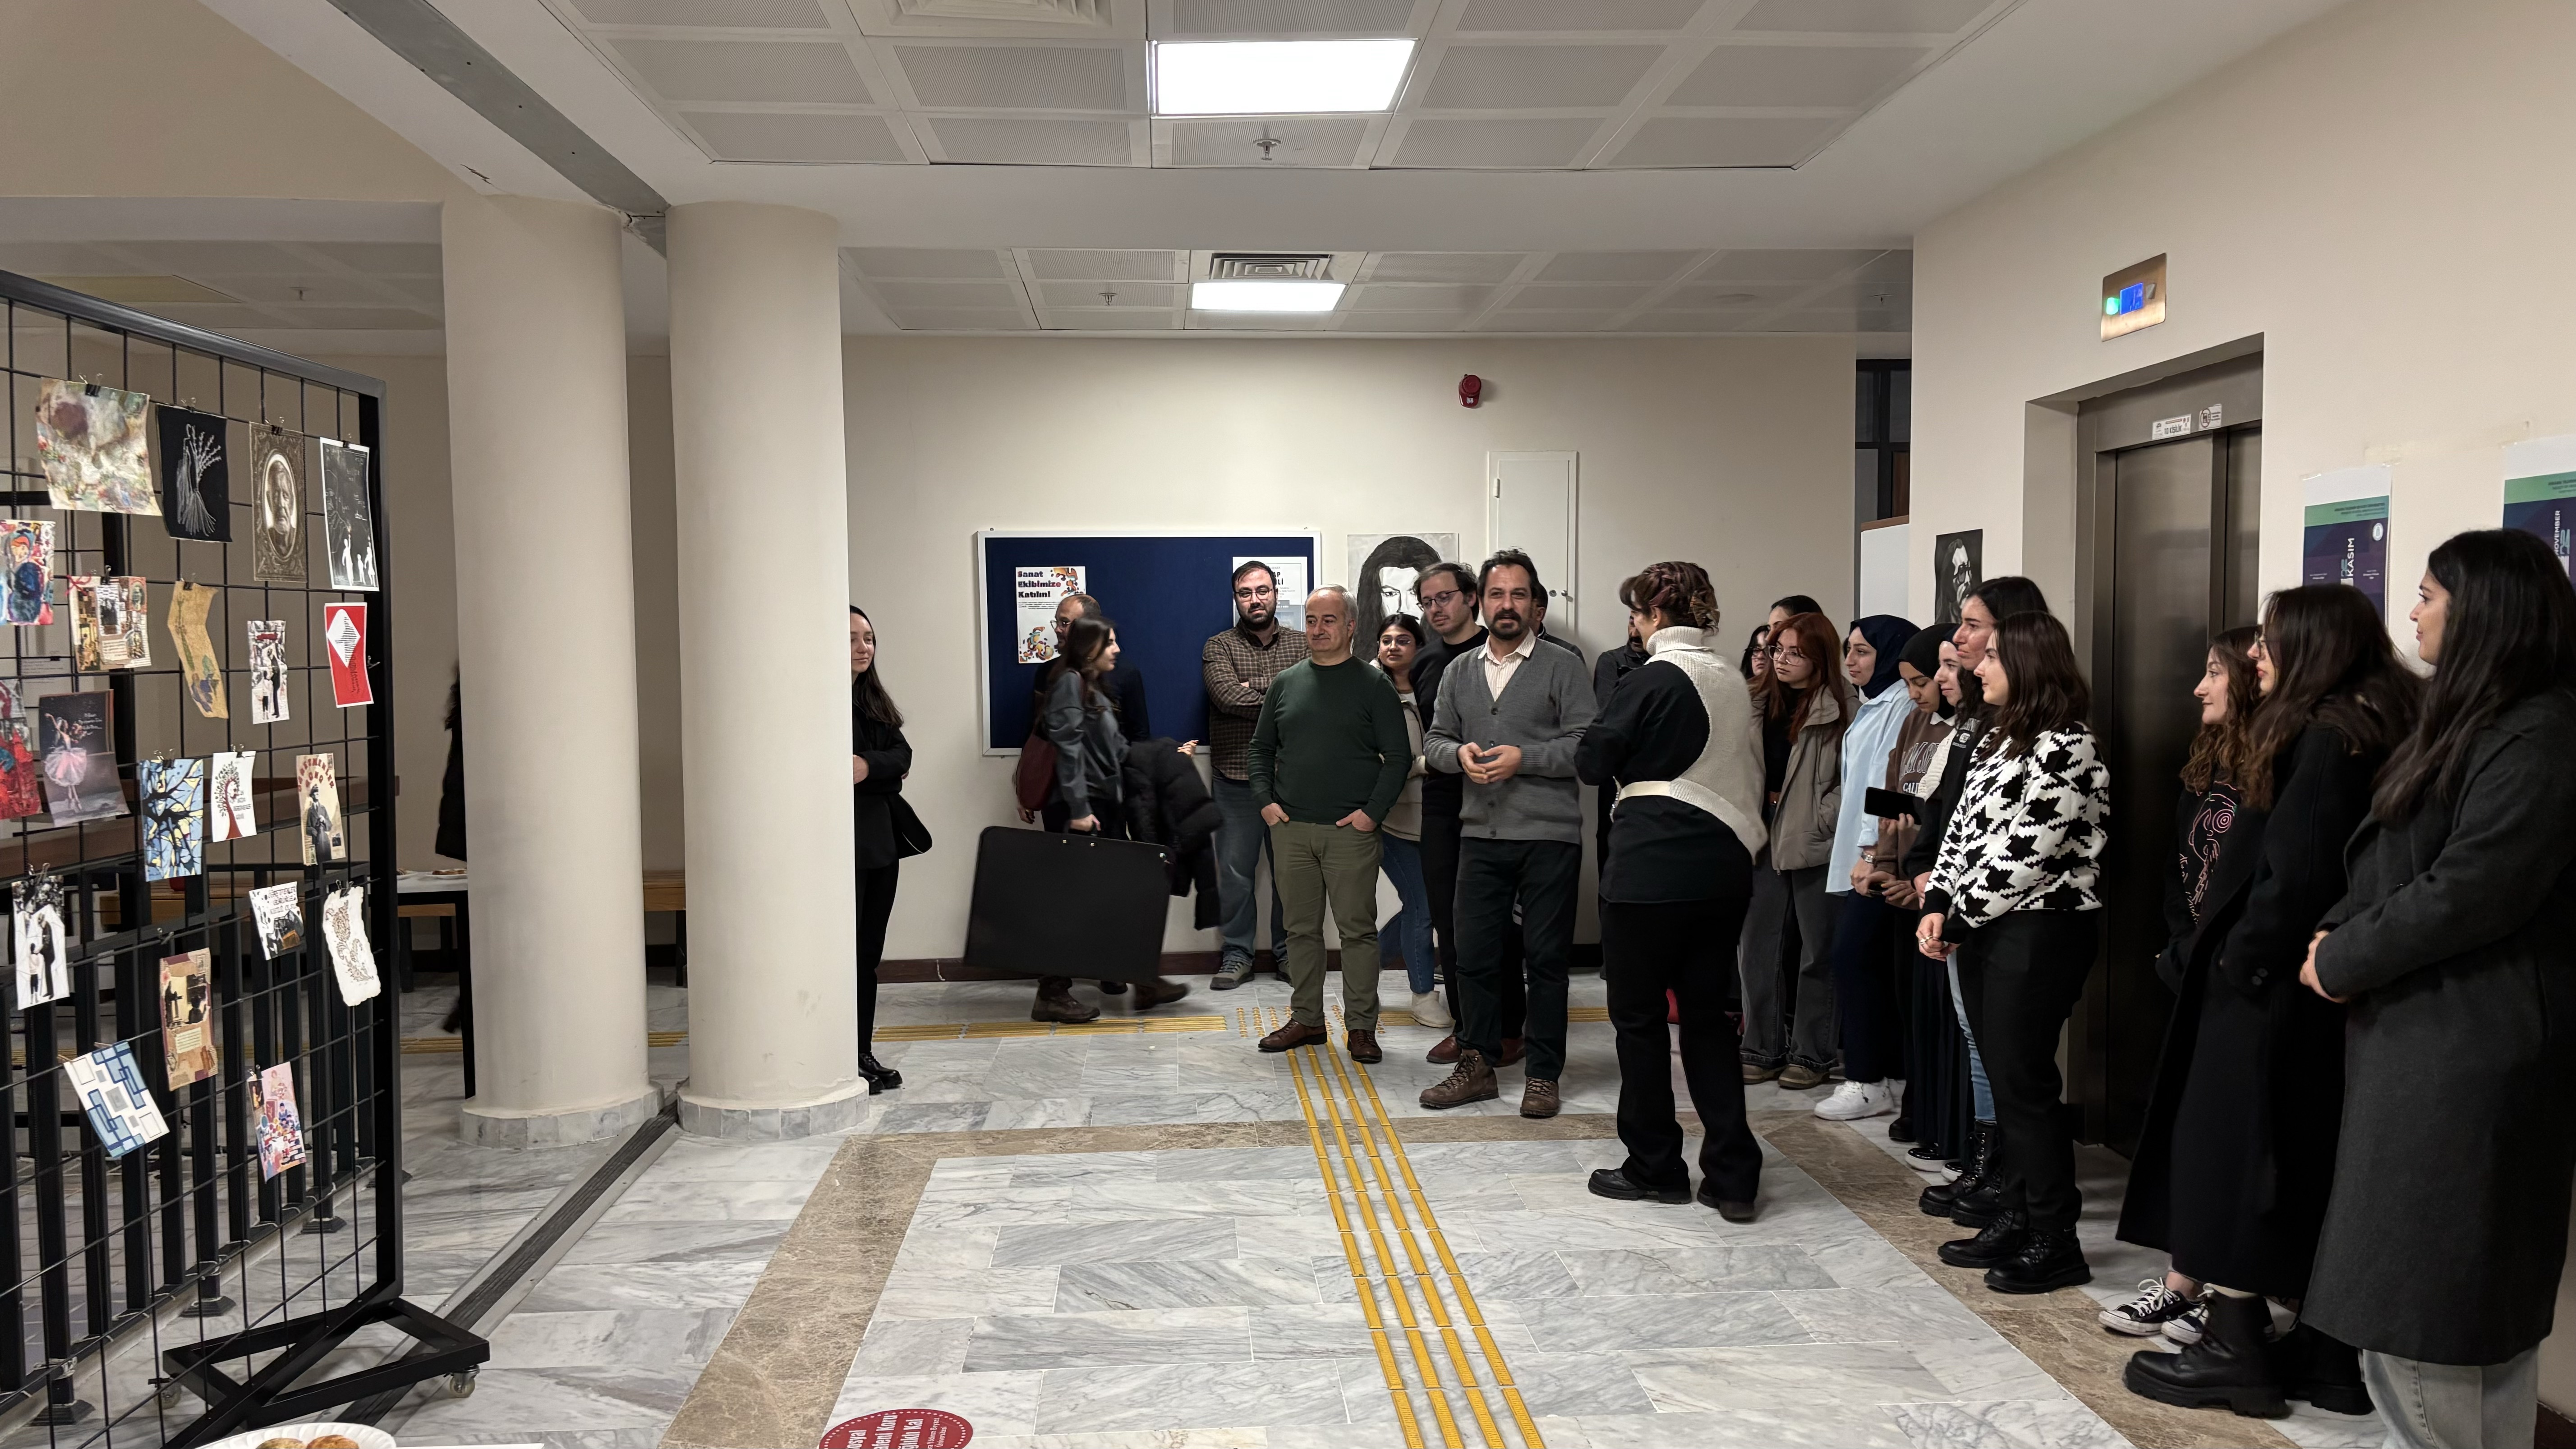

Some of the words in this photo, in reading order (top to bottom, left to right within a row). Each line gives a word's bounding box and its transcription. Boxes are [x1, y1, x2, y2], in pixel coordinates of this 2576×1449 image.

[2346, 538, 2355, 576] KASIM
[1903, 782, 1919, 794] CALI
[876, 1415, 898, 1431] Koru
[903, 1419, 924, 1431] Kal
[846, 1430, 867, 1449] osyal
[871, 1432, 893, 1449] afeni
[898, 1431, 920, 1449] ğlıklı
